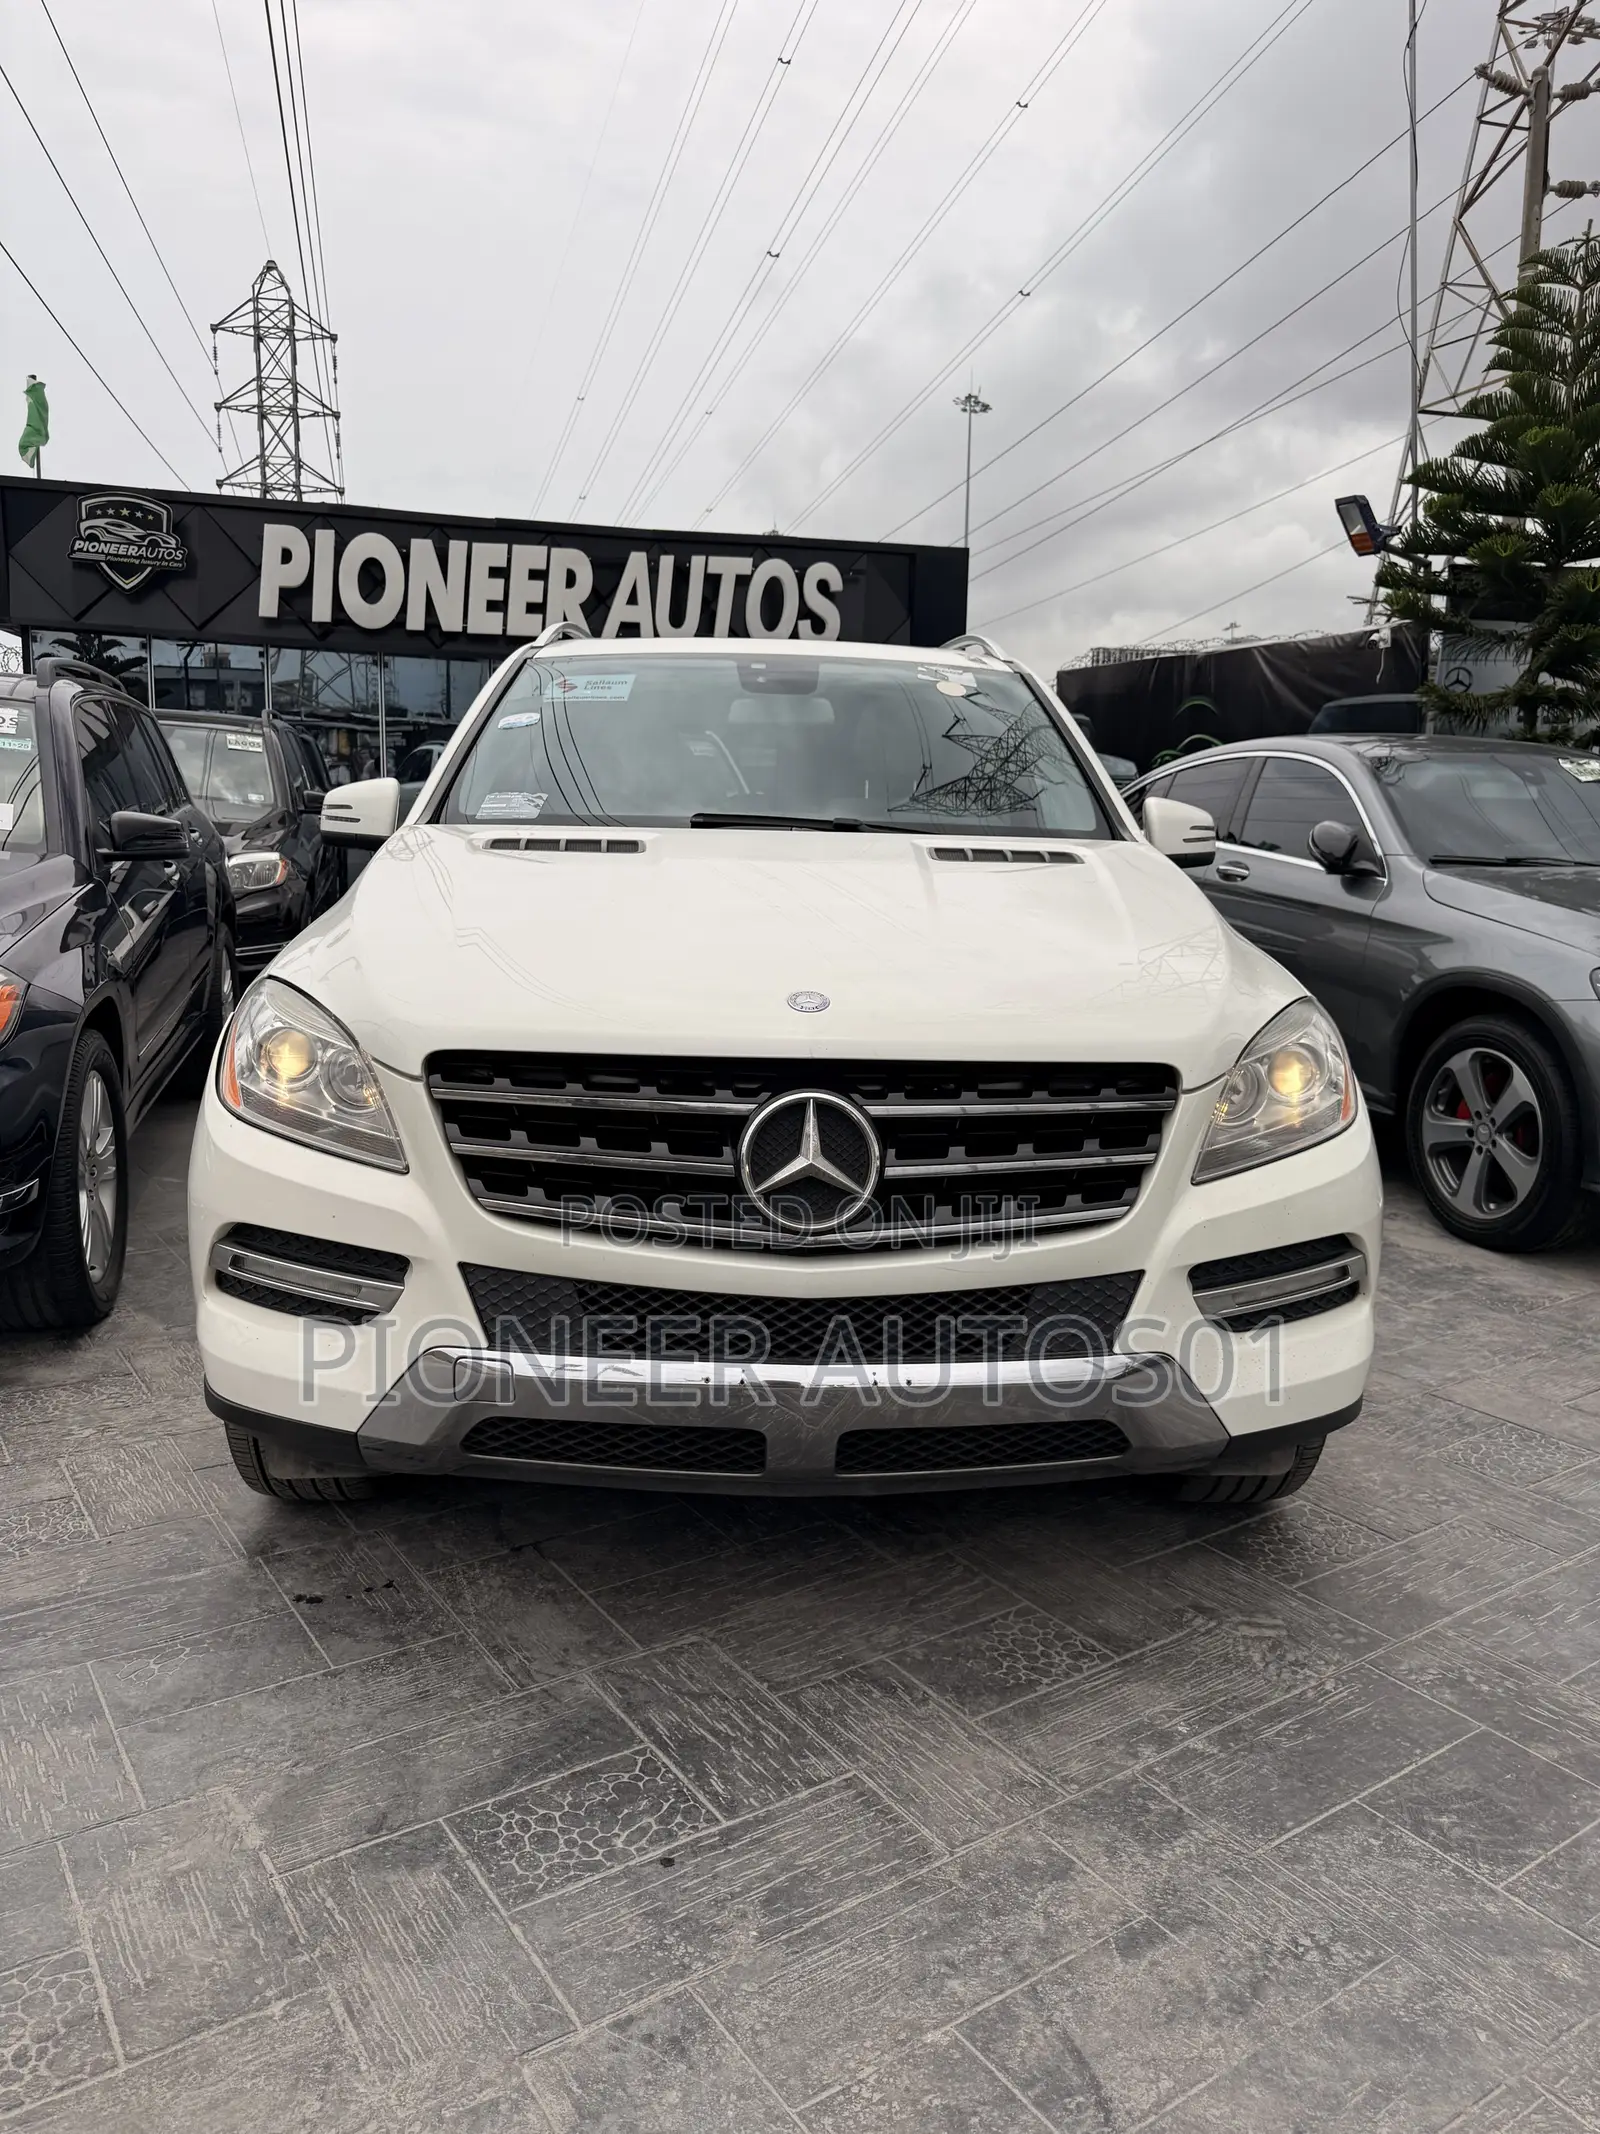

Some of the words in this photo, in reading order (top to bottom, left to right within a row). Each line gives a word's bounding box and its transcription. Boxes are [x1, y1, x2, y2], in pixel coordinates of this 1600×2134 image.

[73, 540, 184, 560] PIONEERAUTOS
[106, 555, 140, 565] Pioneering
[258, 522, 595, 637] PIONEER
[602, 550, 844, 641] AUTOS
[228, 739, 262, 748] LAGOS
